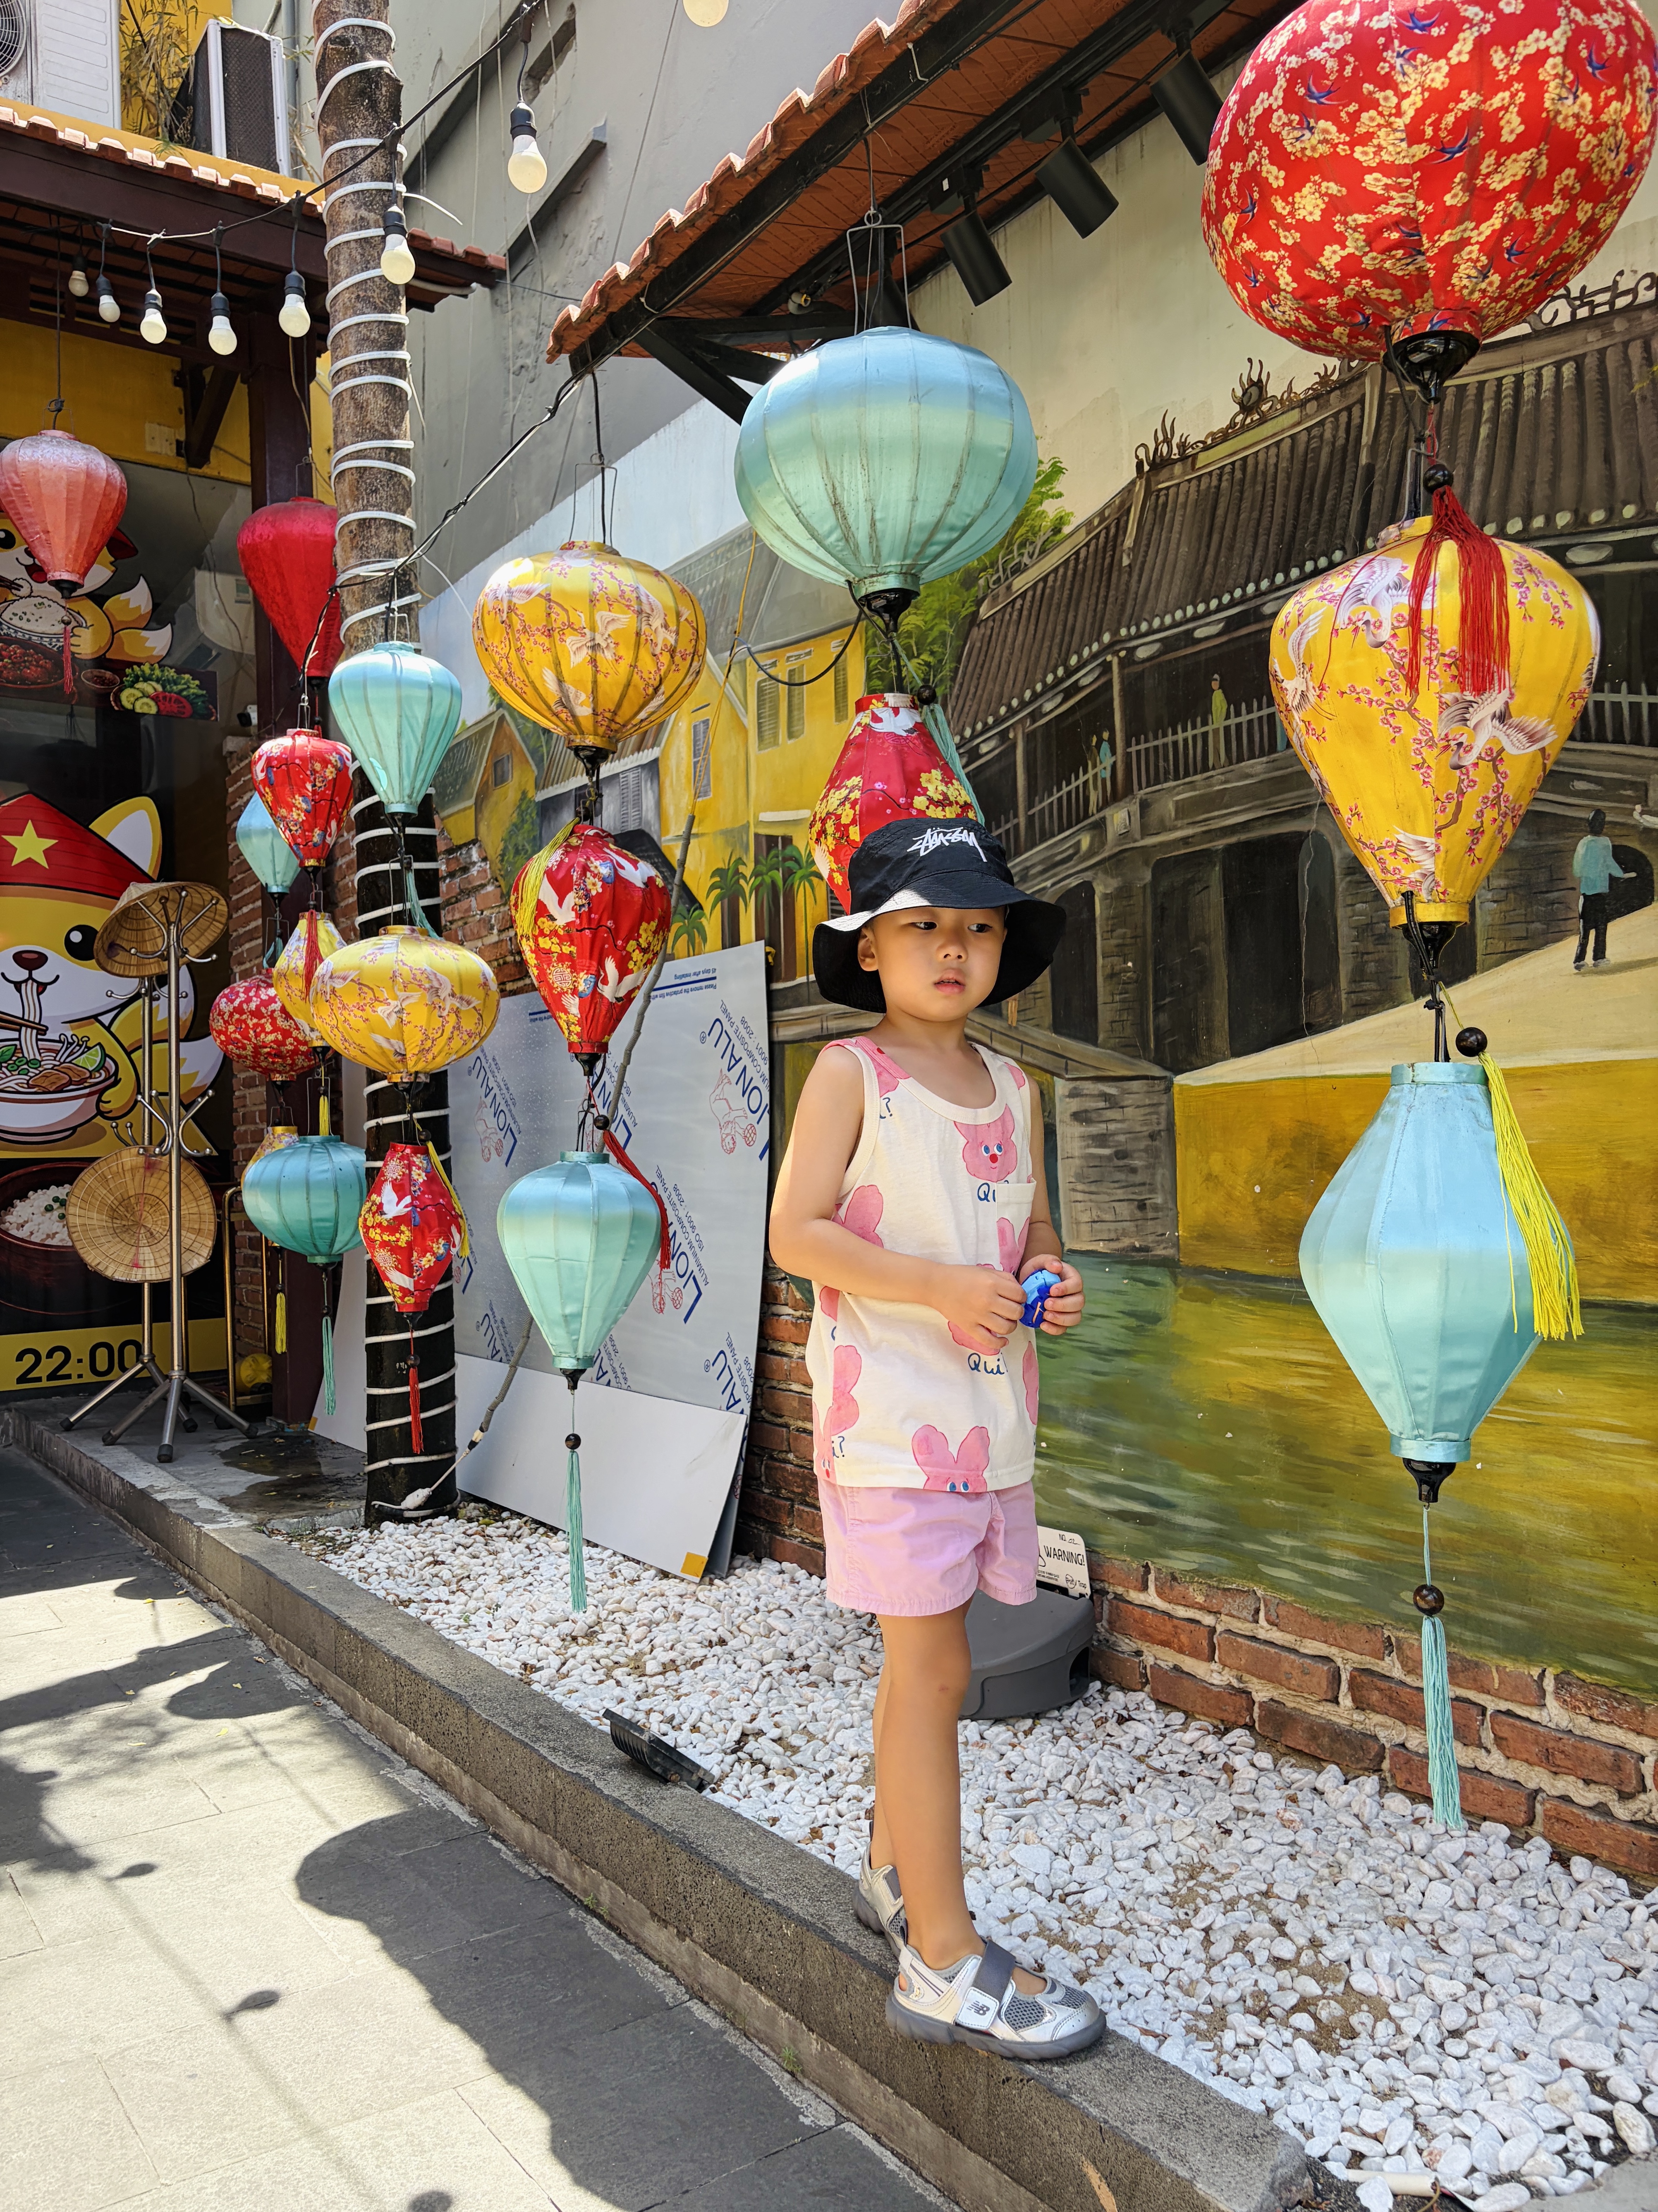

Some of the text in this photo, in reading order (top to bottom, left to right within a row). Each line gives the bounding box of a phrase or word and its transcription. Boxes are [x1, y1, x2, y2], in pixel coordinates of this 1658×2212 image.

[674, 972, 692, 980] installing
[720, 999, 761, 1073] COMPOSITE PANEL
[740, 1016, 754, 1039] 2008
[755, 1042, 769, 1065] 9001
[673, 1183, 685, 1206] 2008
[655, 1164, 709, 1286] ALUMINIUM COMPOSITE PANEL
[685, 1211, 696, 1233] 9001
[695, 1233, 704, 1252] ISO
[725, 1331, 739, 1365] PANEL
[15, 1339, 142, 1385] 22:00
[1043, 1545, 1085, 1566] WARNING!
